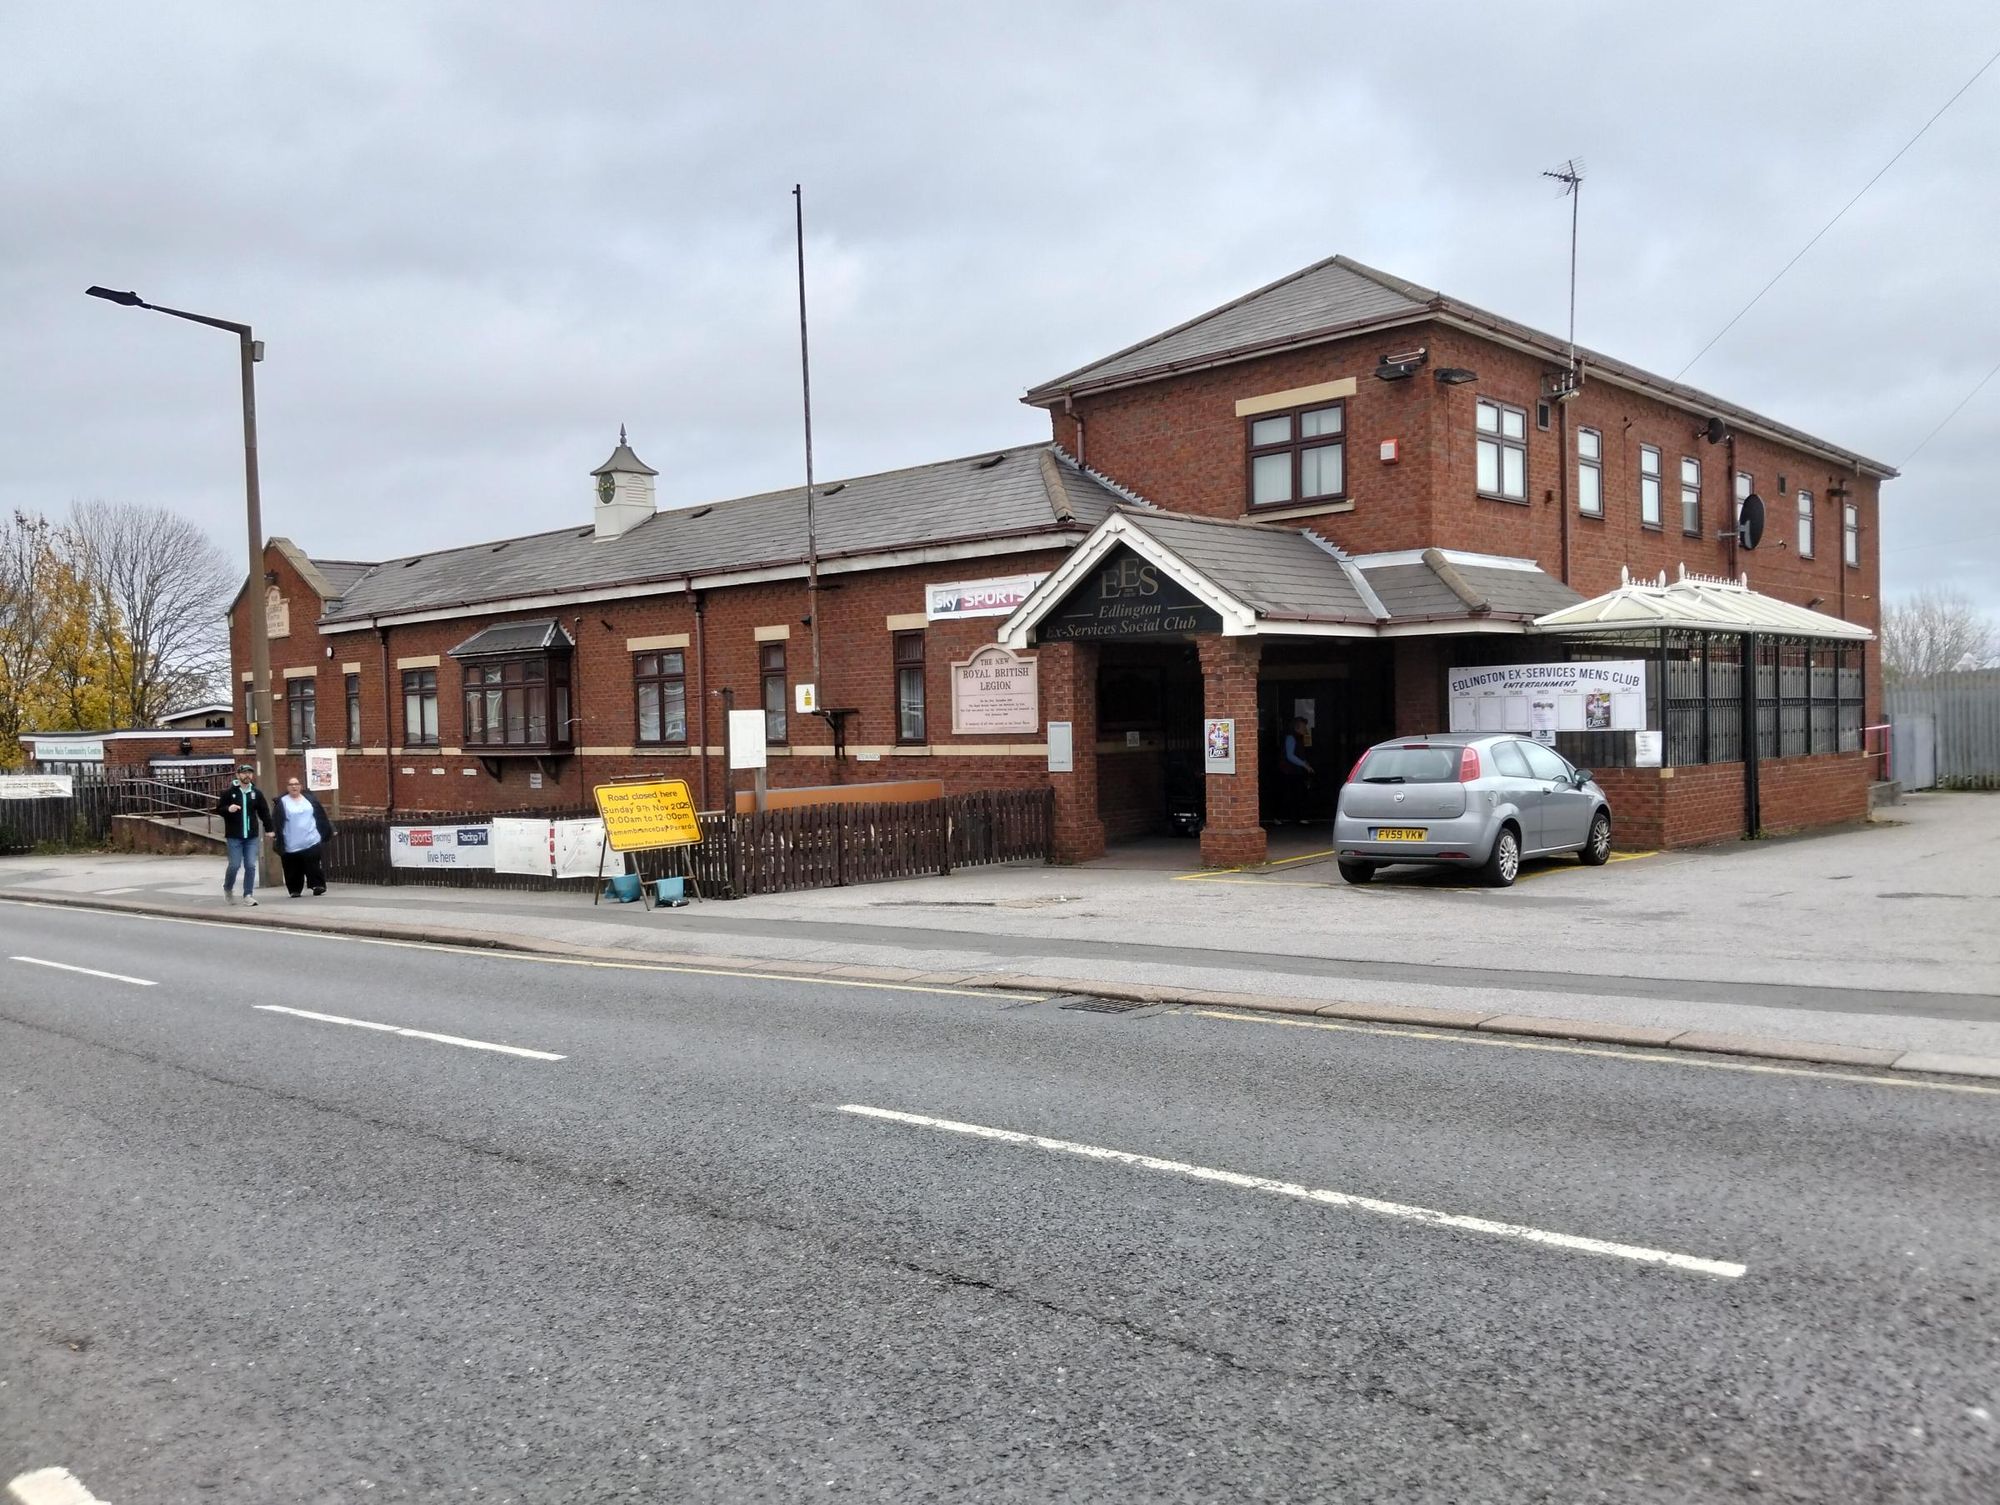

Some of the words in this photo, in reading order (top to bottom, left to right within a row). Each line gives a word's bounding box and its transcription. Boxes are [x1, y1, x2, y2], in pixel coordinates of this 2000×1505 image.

[935, 592, 958, 611] sky
[964, 588, 1025, 607] SPORTS
[1099, 604, 1161, 619] Edlington
[1046, 623, 1116, 638] Ex-Services
[1120, 619, 1160, 634] Social
[1164, 616, 1197, 630] Club
[963, 669, 991, 679] ROYAL
[995, 667, 1029, 677] BRITISH
[1452, 671, 1505, 692] EDLINGTON
[1508, 667, 1576, 680] EX-SERVICES
[1579, 668, 1610, 681] MENS
[1612, 672, 1640, 687] CLUB
[1503, 680, 1577, 688] ENTERTAINMENT
[980, 681, 1011, 691] LEGION
[607, 793, 629, 801] Road
[632, 791, 657, 799] closed
[603, 806, 634, 814] Sunday
[670, 801, 690, 810] 2025
[398, 832, 408, 845] sky
[411, 833, 432, 844] sports
[433, 832, 452, 843] racing
[458, 832, 478, 844] Racing
[478, 831, 487, 841] TV
[1379, 830, 1403, 839] FV59
[1405, 830, 1423, 839] VKW
[427, 851, 439, 863] live
[440, 851, 456, 863] here
